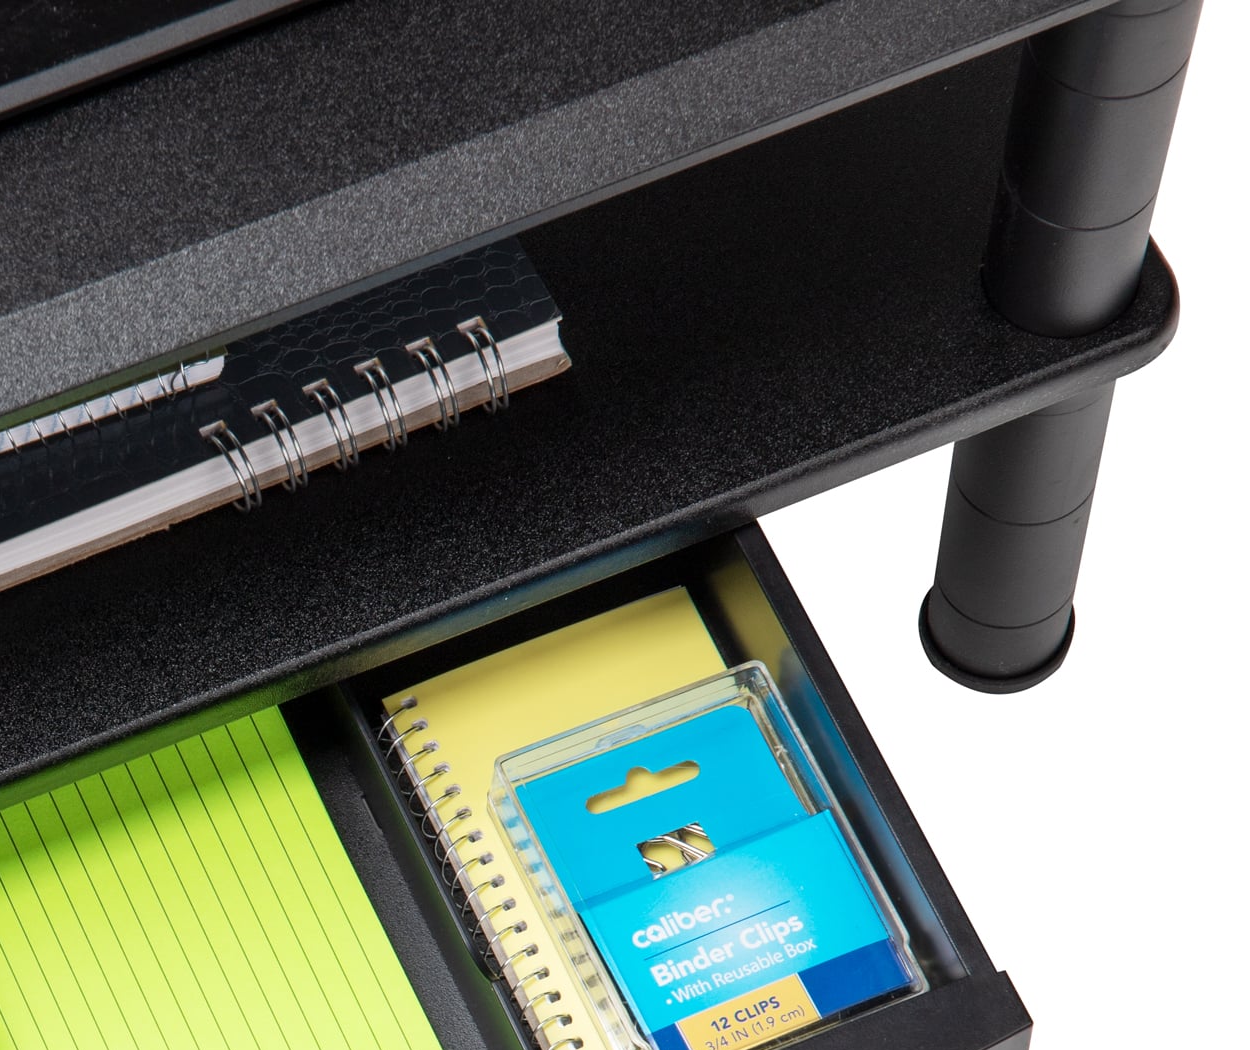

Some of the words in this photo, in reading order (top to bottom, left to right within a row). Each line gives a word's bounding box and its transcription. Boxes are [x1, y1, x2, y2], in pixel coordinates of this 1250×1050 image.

[650, 941, 734, 986] Binder
[739, 915, 803, 949] Clips
[671, 979, 711, 1003] With
[714, 950, 784, 987] Reusable
[785, 937, 818, 960] Box
[710, 1016, 731, 1033] 12
[734, 995, 781, 1022] CLIPS
[731, 1026, 749, 1044] IN
[752, 1016, 777, 1038] (1.9
[779, 1004, 806, 1027] cm)
